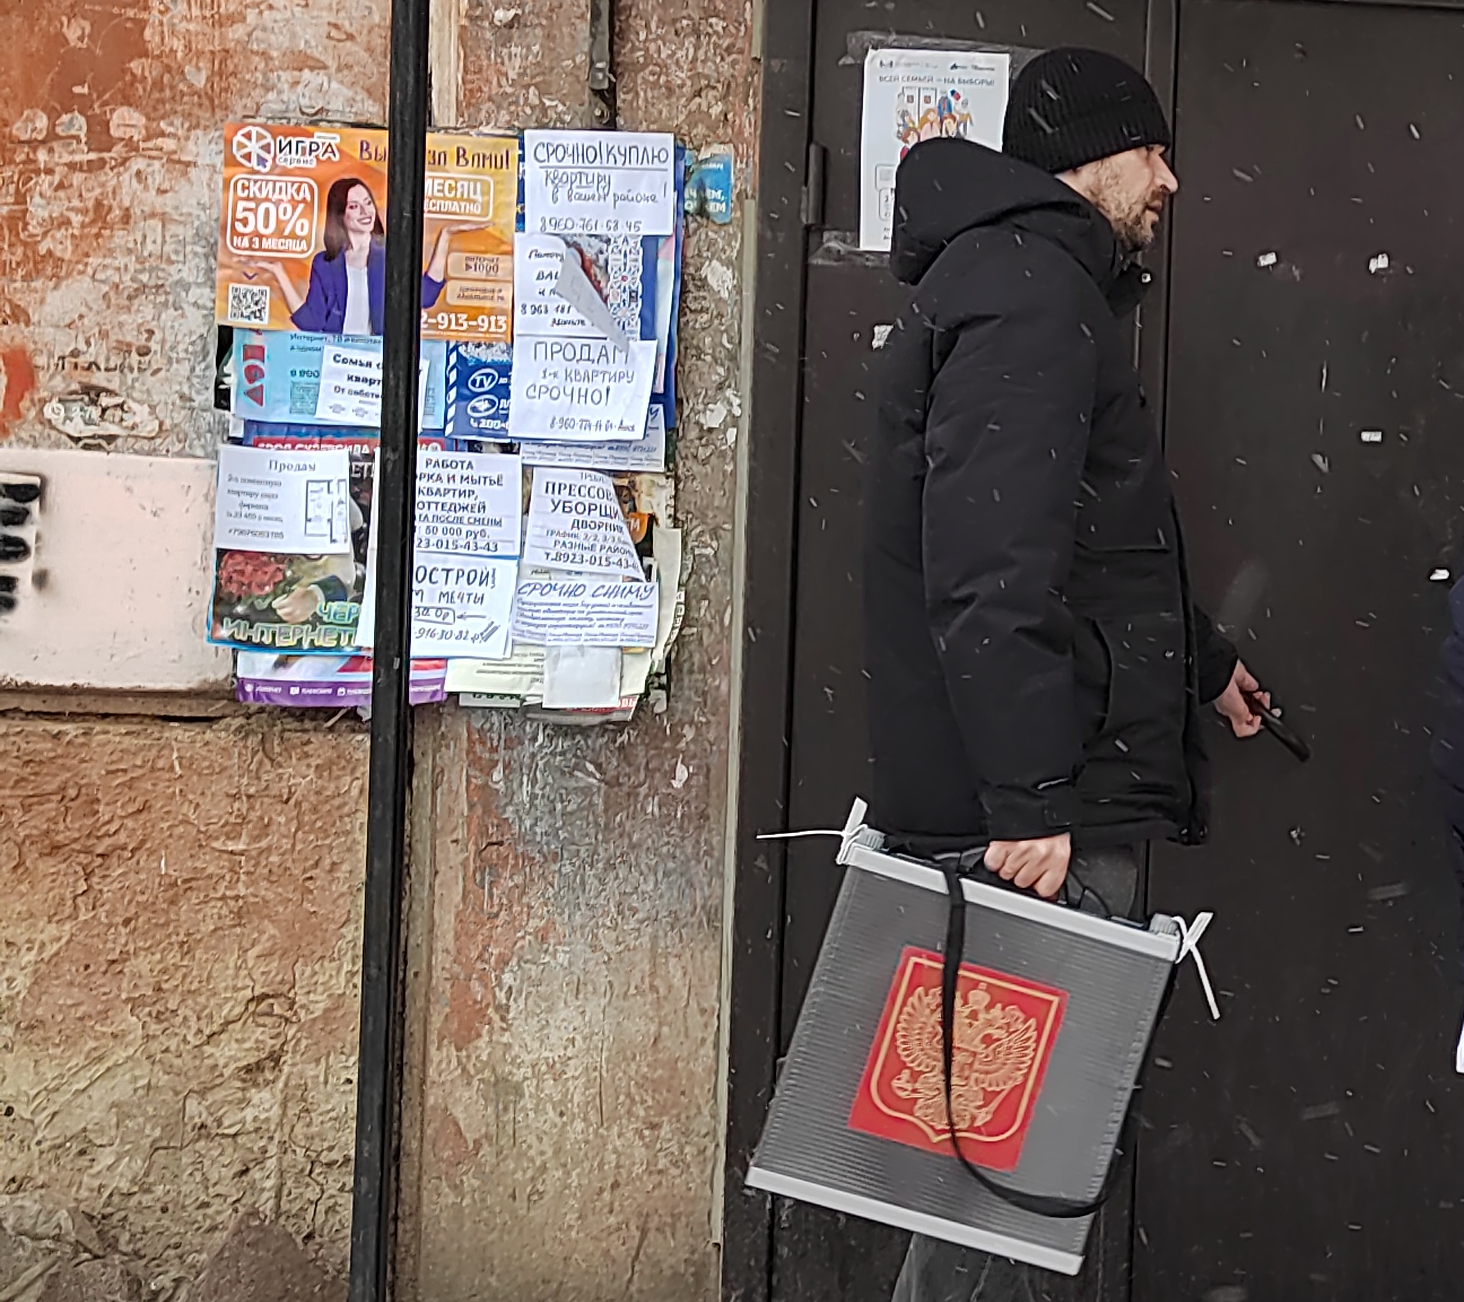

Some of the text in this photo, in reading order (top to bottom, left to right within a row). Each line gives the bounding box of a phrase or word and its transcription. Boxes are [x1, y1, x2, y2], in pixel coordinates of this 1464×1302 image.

[278, 139, 337, 158] ИГРА
[236, 179, 312, 202] СКИДКА
[424, 198, 482, 215] ЕСПЛАТНО
[234, 200, 310, 237] 50%
[233, 235, 249, 248] НА
[252, 237, 259, 248] 3
[475, 375, 493, 388] TV
[268, 459, 317, 474] Продам
[425, 458, 474, 470] РАБОТА
[417, 486, 479, 501] КВАРТИР,
[416, 500, 487, 514] ОТТЕДЖЕЙ
[550, 498, 620, 520] УБОРЩИ
[415, 565, 496, 590] ОСТРОЙ!
[318, 601, 360, 623] ЧЕР
